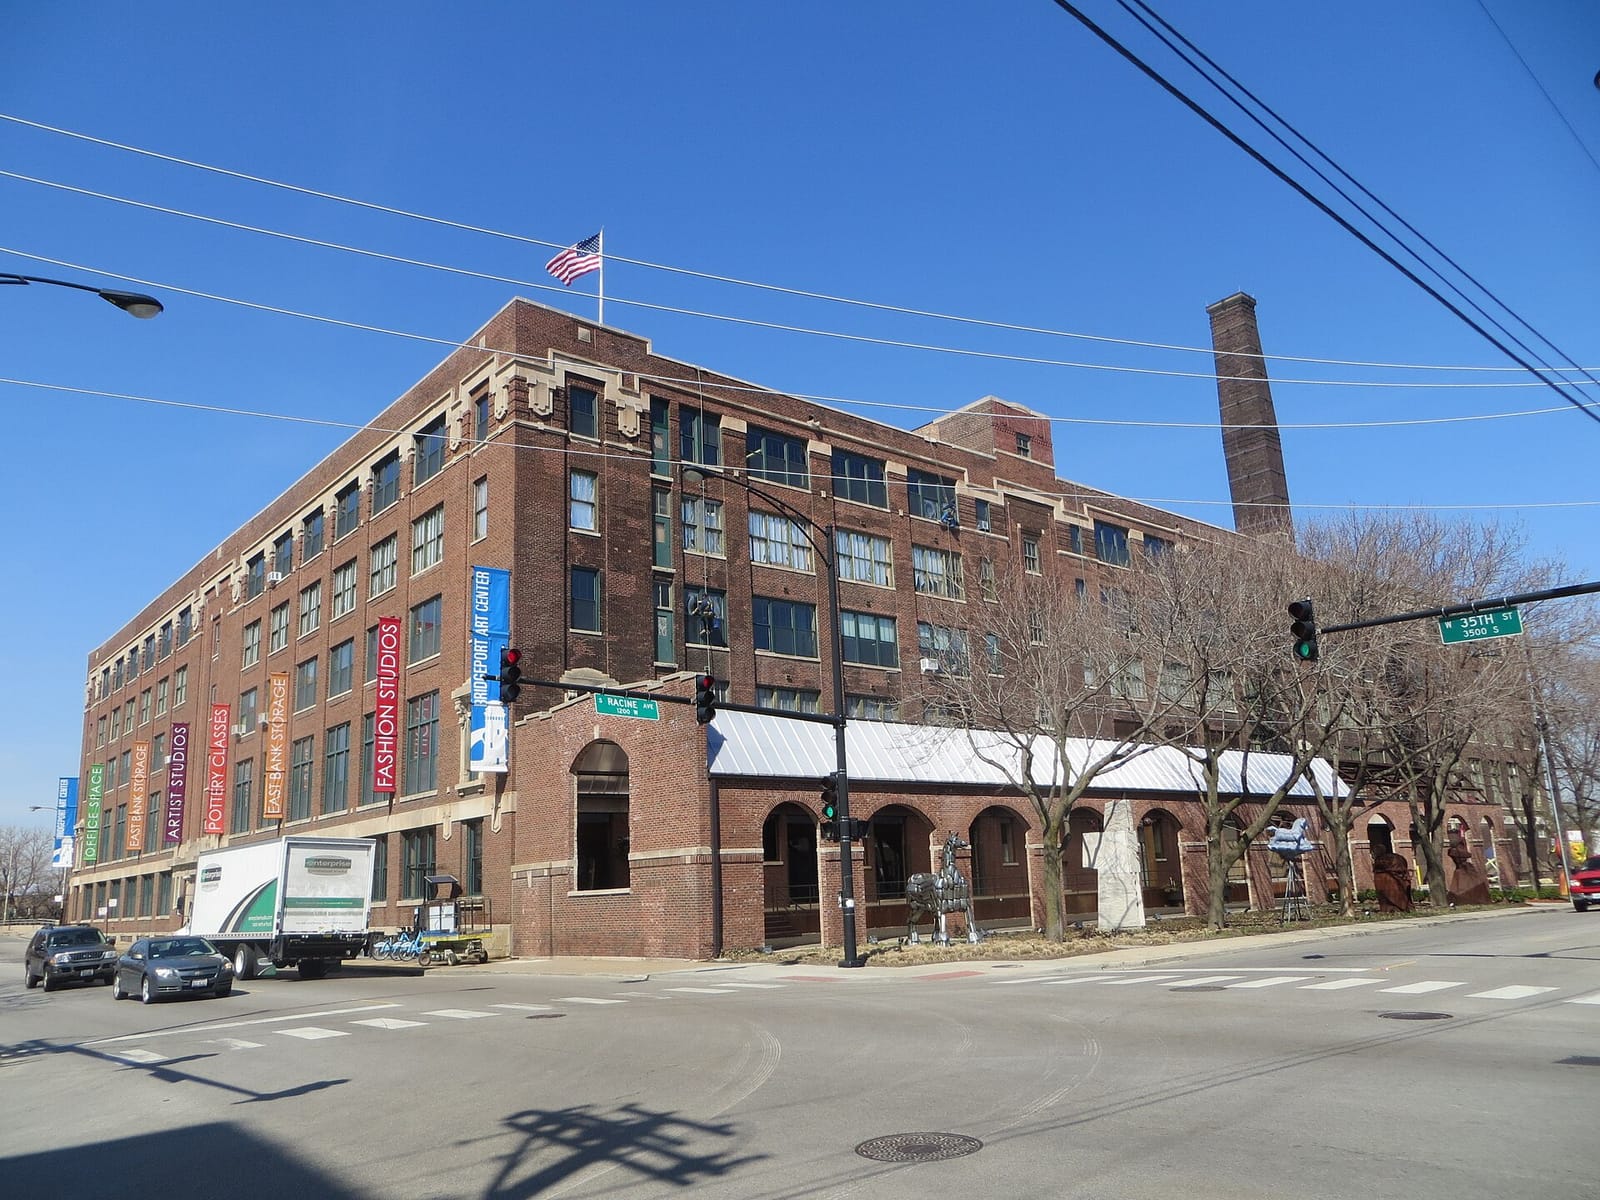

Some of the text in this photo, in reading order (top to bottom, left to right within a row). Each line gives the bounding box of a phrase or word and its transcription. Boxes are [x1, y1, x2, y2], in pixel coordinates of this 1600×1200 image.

[473, 571, 490, 707] BRIDGEPORT ART CENTER
[1444, 612, 1513, 629] W 35TH ST
[1463, 626, 1499, 638] 3500 S
[267, 679, 286, 814] EAST BANK STORAGE
[377, 624, 398, 787] FASHION STUDIOS
[607, 697, 638, 709] RACINE
[85, 767, 103, 857] OFFICE SPACE
[130, 745, 147, 847] EAST BANK STORAGE
[168, 727, 186, 839] ARTIST STUDIOS
[208, 709, 227, 830] POTTERY CLASSES
